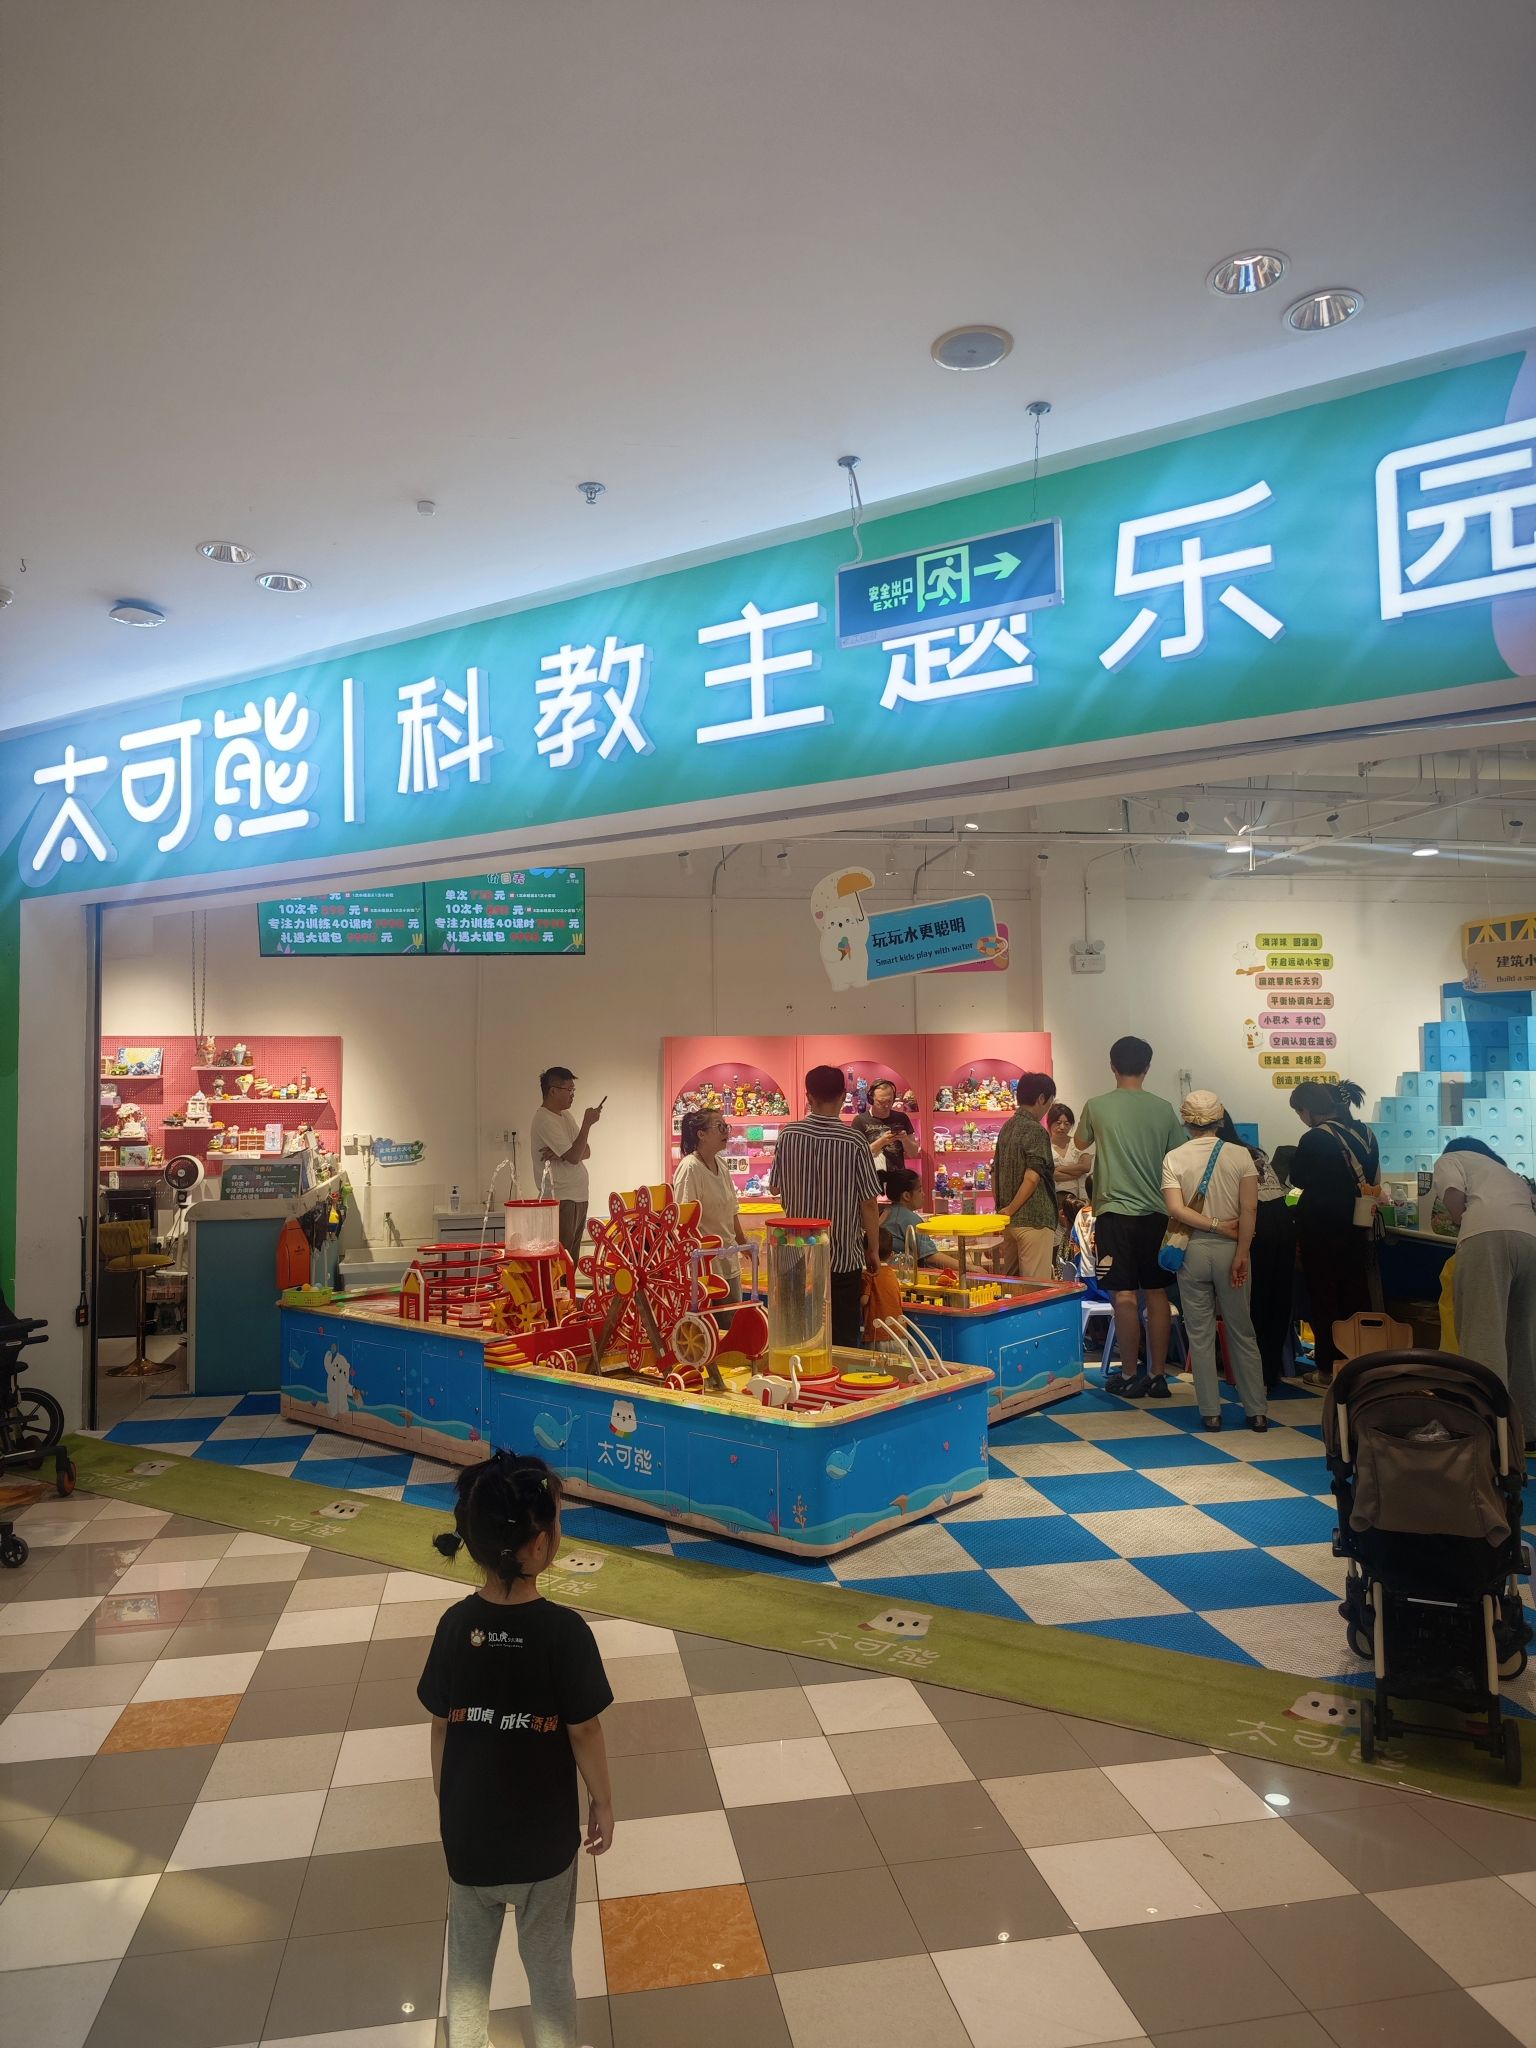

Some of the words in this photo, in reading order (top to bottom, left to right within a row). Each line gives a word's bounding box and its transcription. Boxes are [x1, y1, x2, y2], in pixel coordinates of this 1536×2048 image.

[869, 578, 913, 602] 安全出口
[873, 595, 909, 612] EXIT
[32, 692, 310, 872] 太可熊
[445, 890, 468, 900] 单次
[494, 890, 506, 900] 元
[278, 904, 318, 915] 10次卡
[349, 905, 361, 915] 元
[445, 904, 483, 915] 10次卡
[512, 905, 524, 915] 元
[268, 918, 372, 930] 专注力训练40课时
[408, 919, 420, 929] 元
[434, 918, 535, 929] 专注力训练40课时
[568, 918, 580, 929] 元
[381, 932, 393, 943] 元
[542, 932, 554, 942] 元
[872, 917, 966, 948] 玩玩水更聪明
[1262, 937, 1287, 947] 海洋球
[875, 957, 898, 967] Smart
[899, 954, 915, 962] kids
[916, 951, 933, 960] play
[934, 946, 950, 956] with
[951, 942, 973, 952] water
[1271, 957, 1330, 967] 开启运动小宇宙
[1271, 996, 1331, 1006] 平衡协调向上走
[1264, 1015, 1290, 1025] 小积木
[1295, 1016, 1321, 1025] 手中忙
[1264, 1056, 1290, 1065] 搭城堡
[1295, 1056, 1321, 1065] 建桥梁
[598, 1440, 652, 1475] 太可熊
[802, 1630, 941, 1669] 太可熊
[448, 1707, 495, 1725] 健如虎
